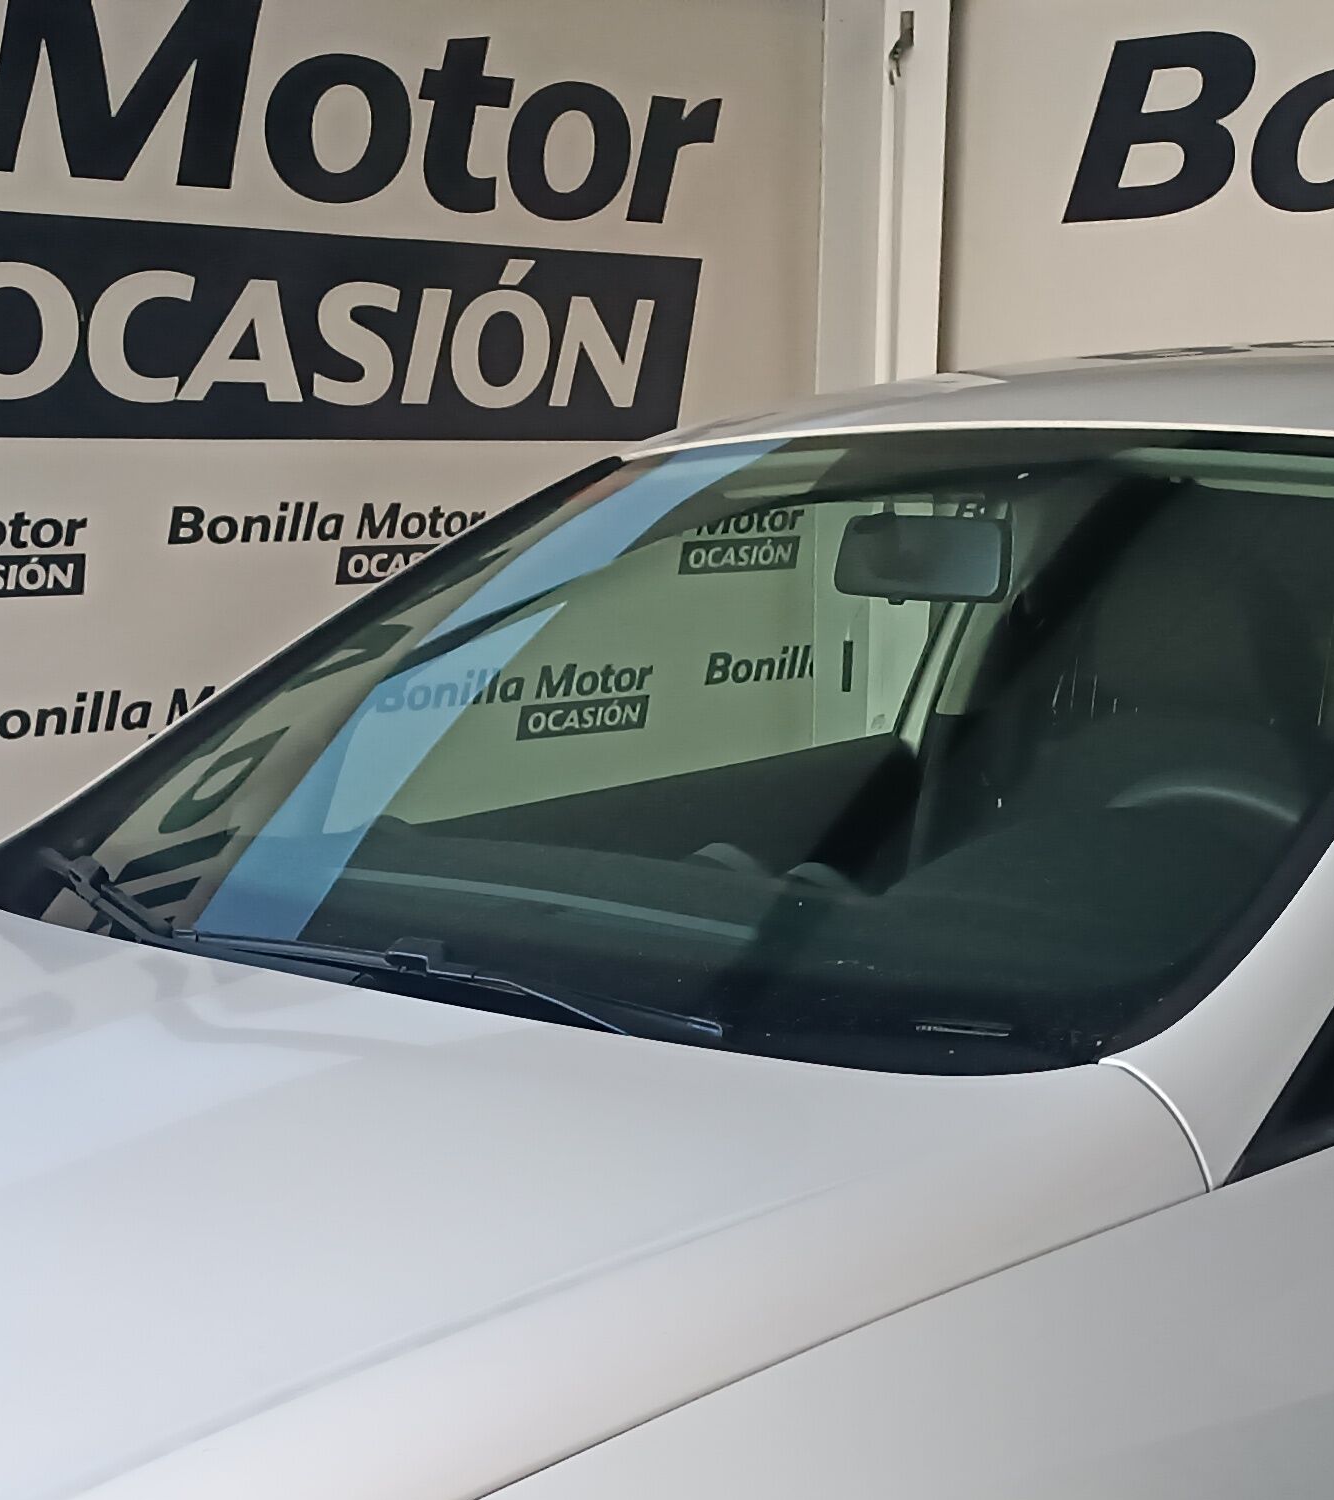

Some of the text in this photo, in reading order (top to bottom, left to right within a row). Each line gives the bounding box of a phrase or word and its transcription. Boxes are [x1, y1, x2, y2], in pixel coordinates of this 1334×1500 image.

[168, 502, 344, 545] Bonilla
[688, 538, 793, 569] OCASIÓN
[535, 661, 653, 700] Motor
[527, 700, 642, 734] OCASIÓN
